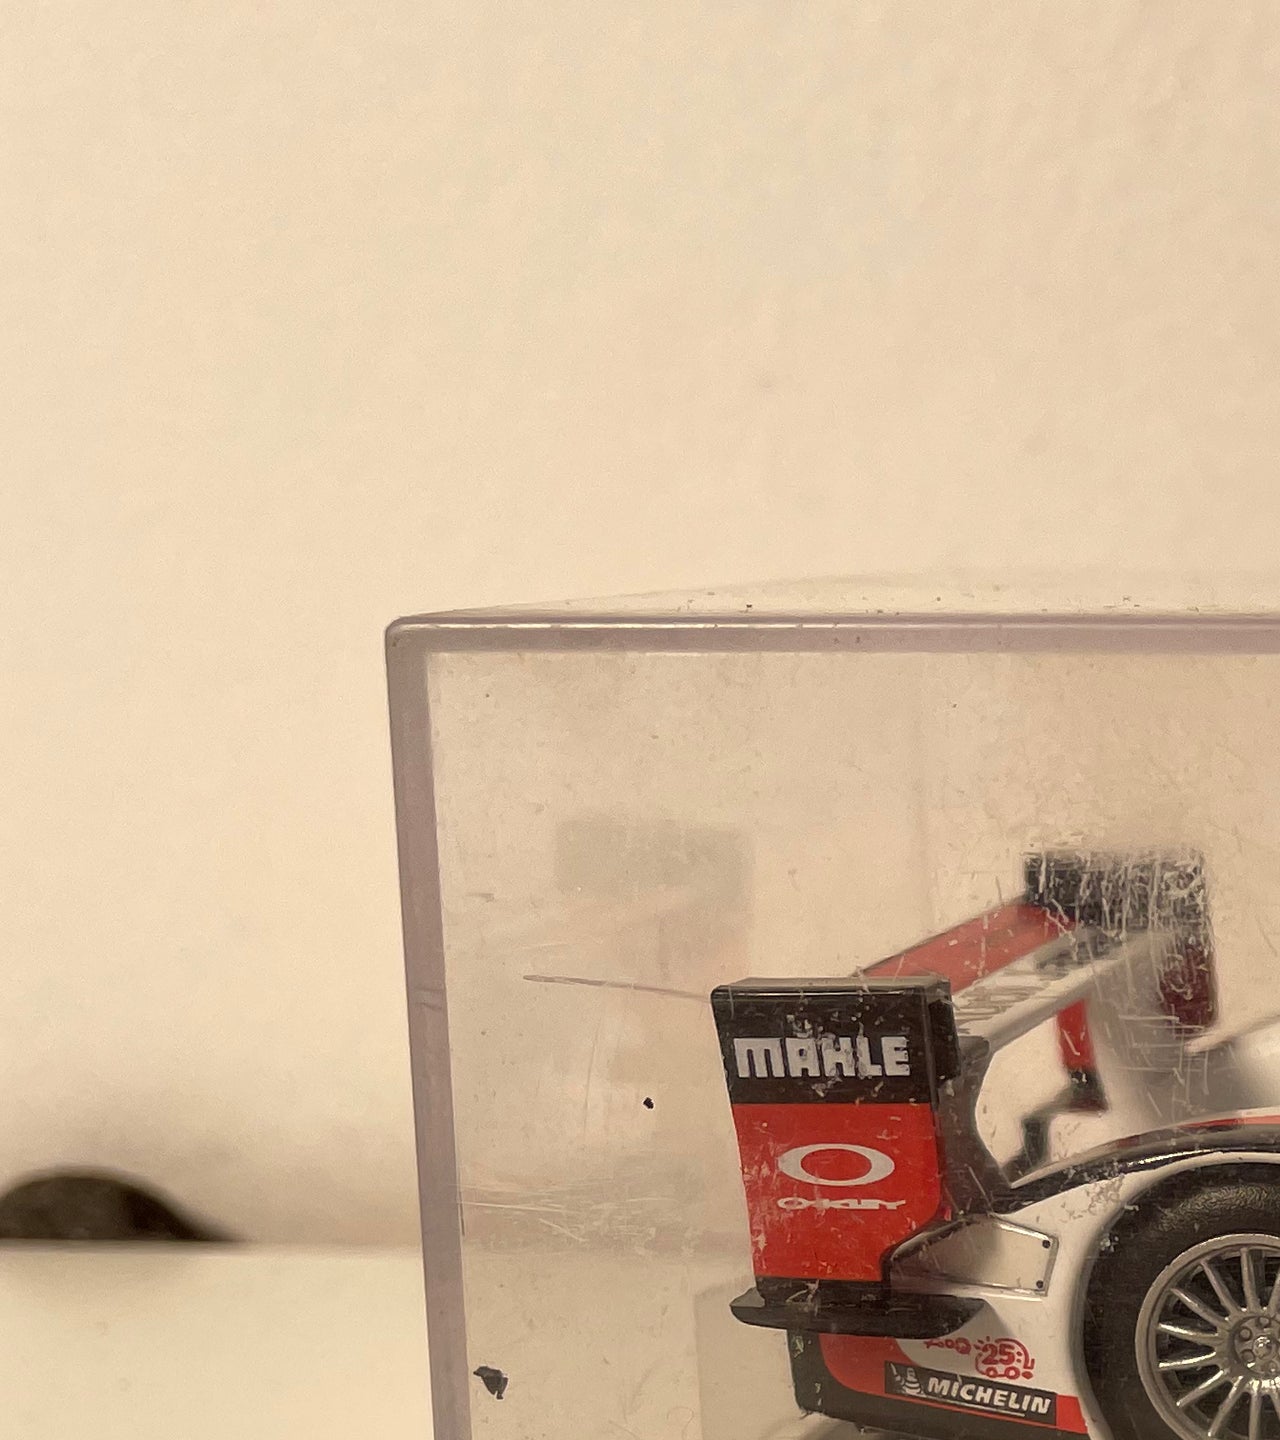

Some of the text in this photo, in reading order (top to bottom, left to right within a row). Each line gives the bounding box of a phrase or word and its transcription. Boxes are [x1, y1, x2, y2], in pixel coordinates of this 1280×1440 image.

[733, 1036, 910, 1078] MAHLE
[982, 1342, 1016, 1366] 25
[928, 1376, 1051, 1415] MICHELIN
